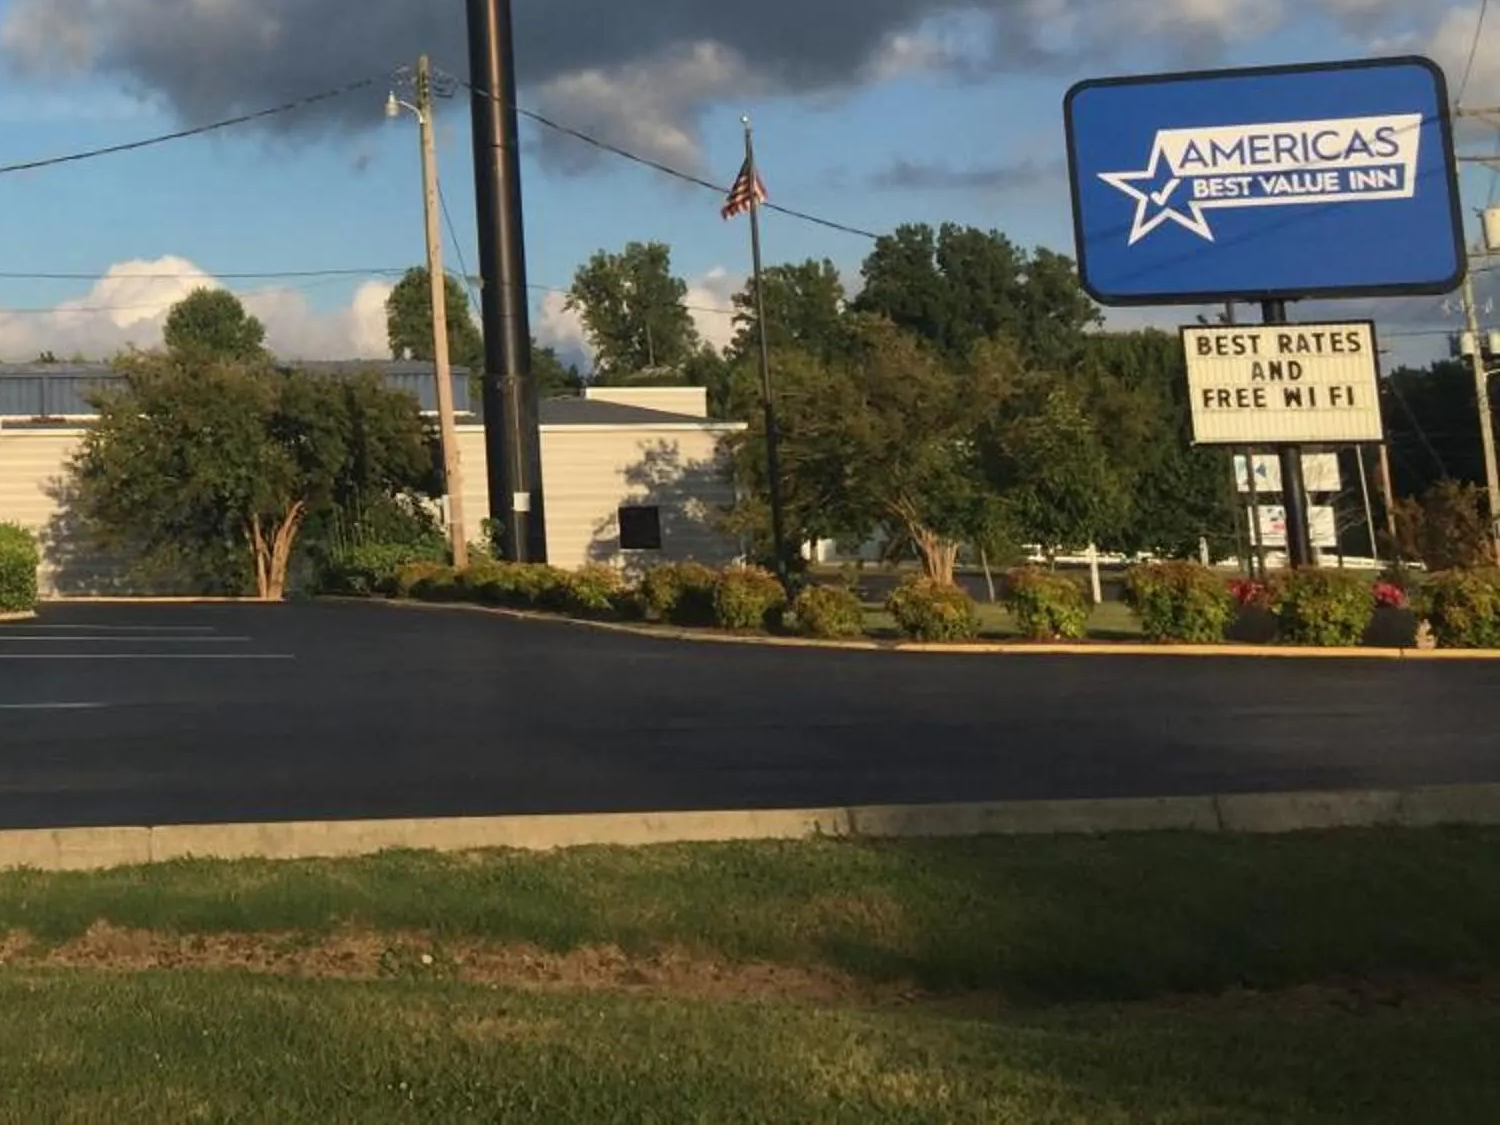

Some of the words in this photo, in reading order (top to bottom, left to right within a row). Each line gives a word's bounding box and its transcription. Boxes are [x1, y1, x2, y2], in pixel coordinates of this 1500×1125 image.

[1179, 126, 1399, 168] AMERICAS
[1193, 177, 1253, 198] BEST
[1258, 171, 1340, 194] VALUE
[1349, 168, 1398, 191] INN
[1196, 334, 1261, 356] BEST
[1277, 331, 1362, 354] RATES
[1251, 360, 1303, 381] AND
[1202, 388, 1267, 408] FREE
